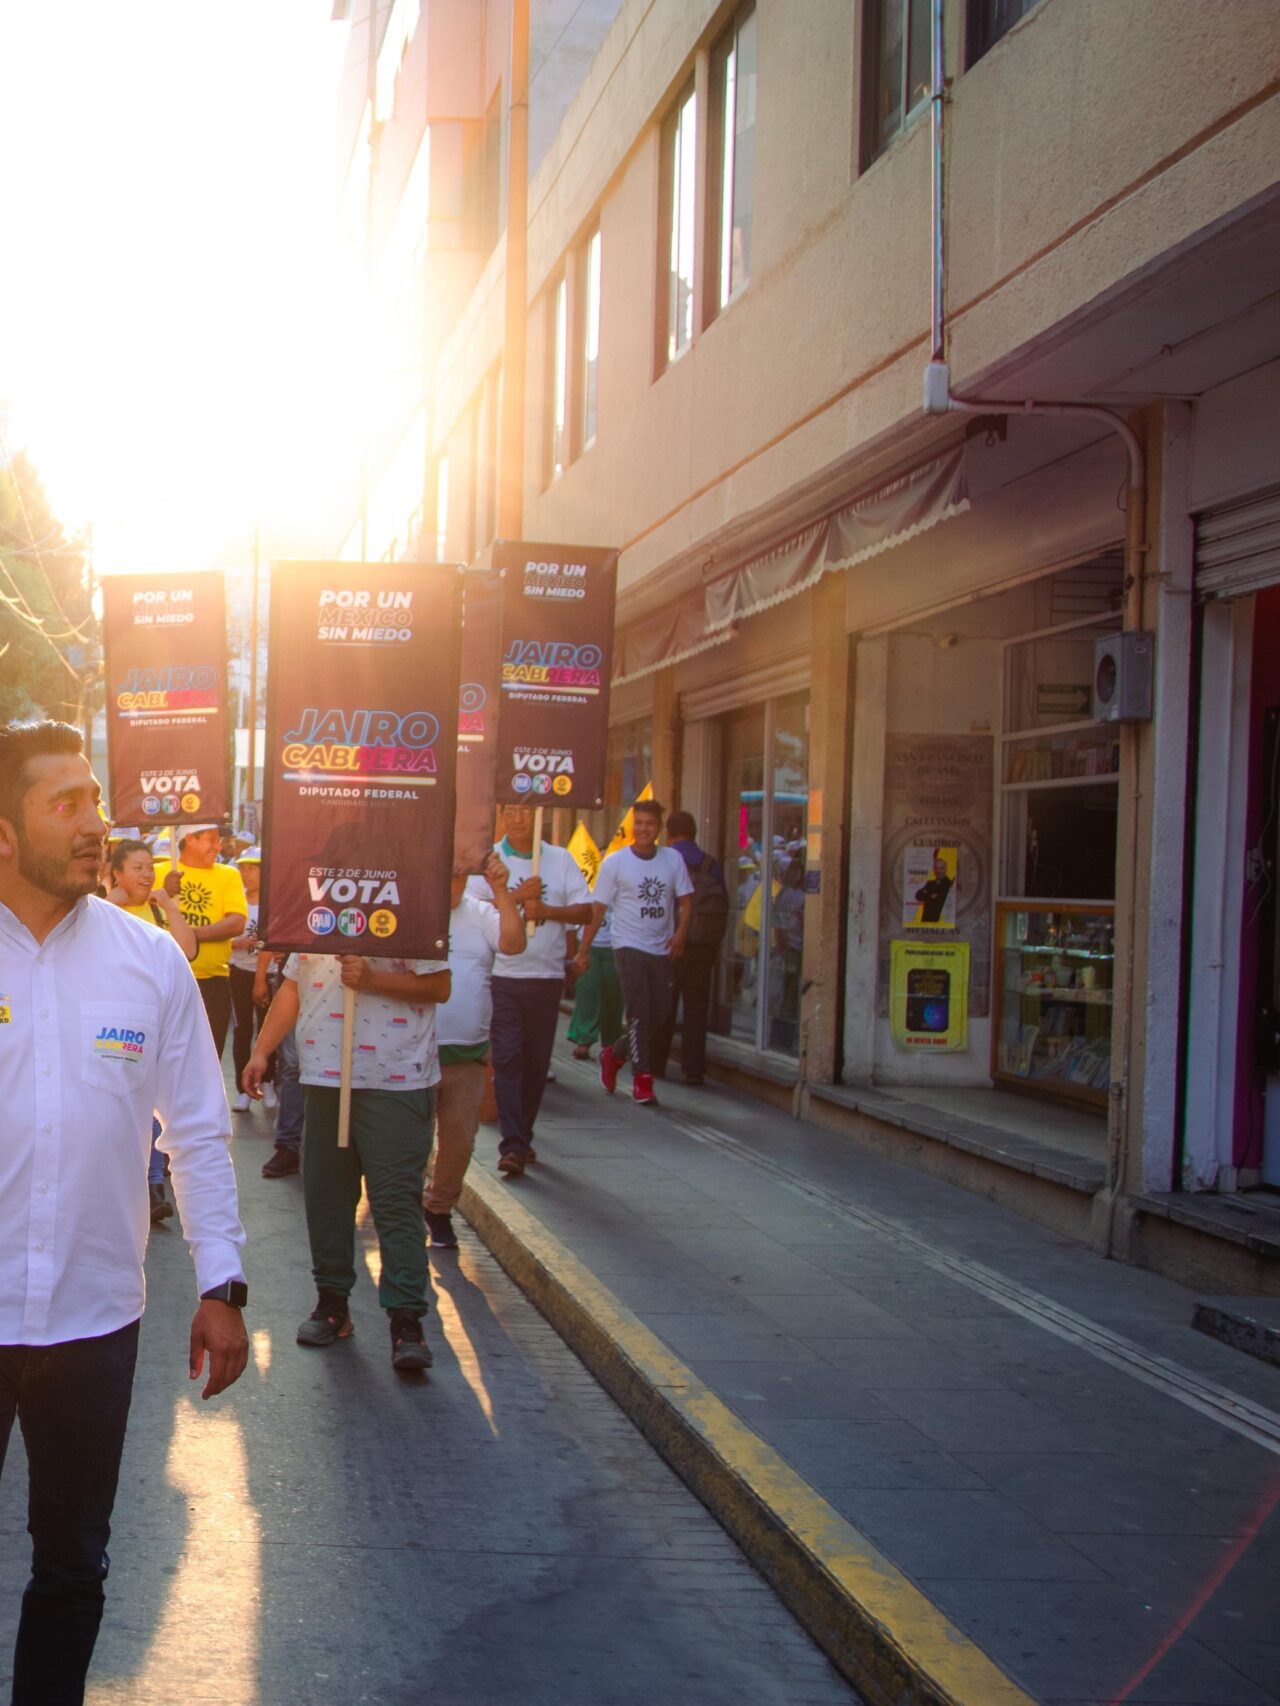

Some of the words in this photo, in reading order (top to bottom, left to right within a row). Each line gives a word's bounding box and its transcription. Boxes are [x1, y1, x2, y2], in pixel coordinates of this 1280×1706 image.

[525, 562, 559, 575] POR
[563, 564, 587, 576] UN
[132, 590, 166, 603] POR
[171, 589, 193, 602] UN
[318, 590, 370, 608] POR
[376, 591, 412, 608] UN
[523, 585, 544, 596] SIN
[546, 587, 586, 598] MIEDO
[133, 614, 153, 625] SIN
[156, 613, 195, 624] MIEDO
[318, 626, 347, 640] SIN
[352, 627, 412, 641] MIEDO
[504, 640, 602, 670] JAIRO
[117, 665, 217, 693] JAIRO
[501, 663, 600, 685] CABRERA
[509, 692, 549, 701] DIPUTADO
[551, 694, 587, 703] FEDERAL
[129, 718, 170, 727] DIPUTADO
[172, 716, 208, 725] FEDERAL
[284, 708, 439, 749] JAIRO
[282, 744, 437, 772] CABRERA
[513, 753, 574, 773] VOTA
[140, 775, 200, 793] VOTA
[299, 787, 361, 798] DIPUTADO
[364, 788, 418, 799] FEDERAL
[309, 867, 335, 877] ESTE
[337, 868, 344, 877] 2
[346, 869, 361, 878] DE
[363, 869, 397, 879] JUNIO
[308, 877, 400, 905] VOTA
[641, 906, 665, 919] PRD
[312, 913, 331, 928] PAN
[341, 913, 362, 928] PRI
[96, 1027, 145, 1045] JAIRO
[95, 1039, 144, 1054] RERA
